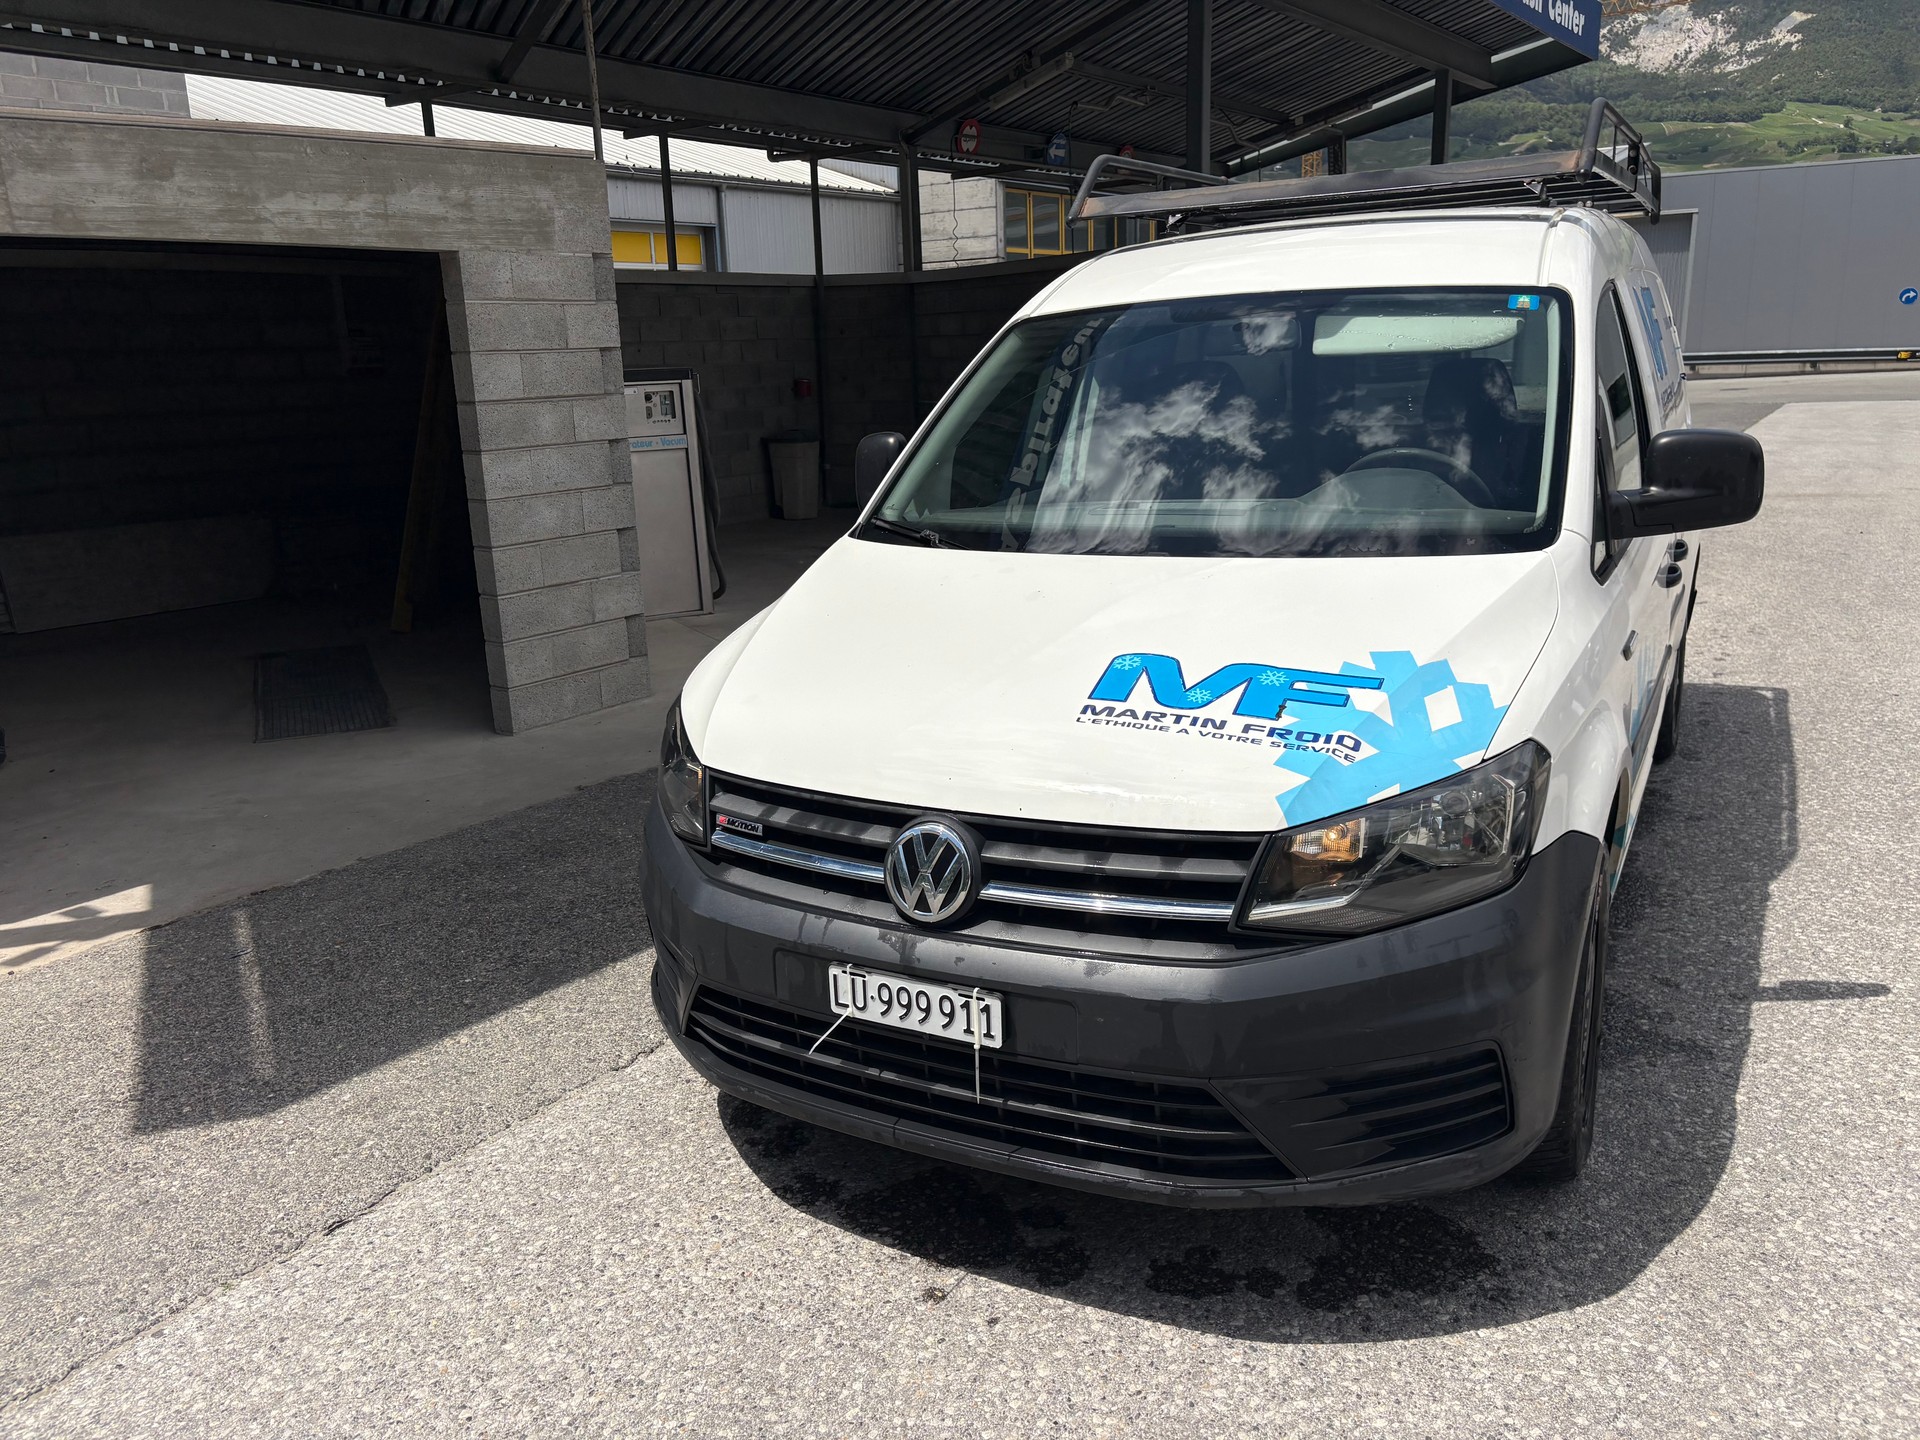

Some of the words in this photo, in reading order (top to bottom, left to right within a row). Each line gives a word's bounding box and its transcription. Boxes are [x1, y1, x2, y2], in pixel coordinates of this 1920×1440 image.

[1549, 0, 1585, 36] Center
[1087, 652, 1385, 721] MF
[1076, 717, 1170, 733] L'ETHIQUE
[1198, 730, 1263, 746] VOTRE
[1269, 740, 1357, 763] SERVICE
[1079, 704, 1229, 730] MARTIN
[1242, 723, 1363, 753] FROID
